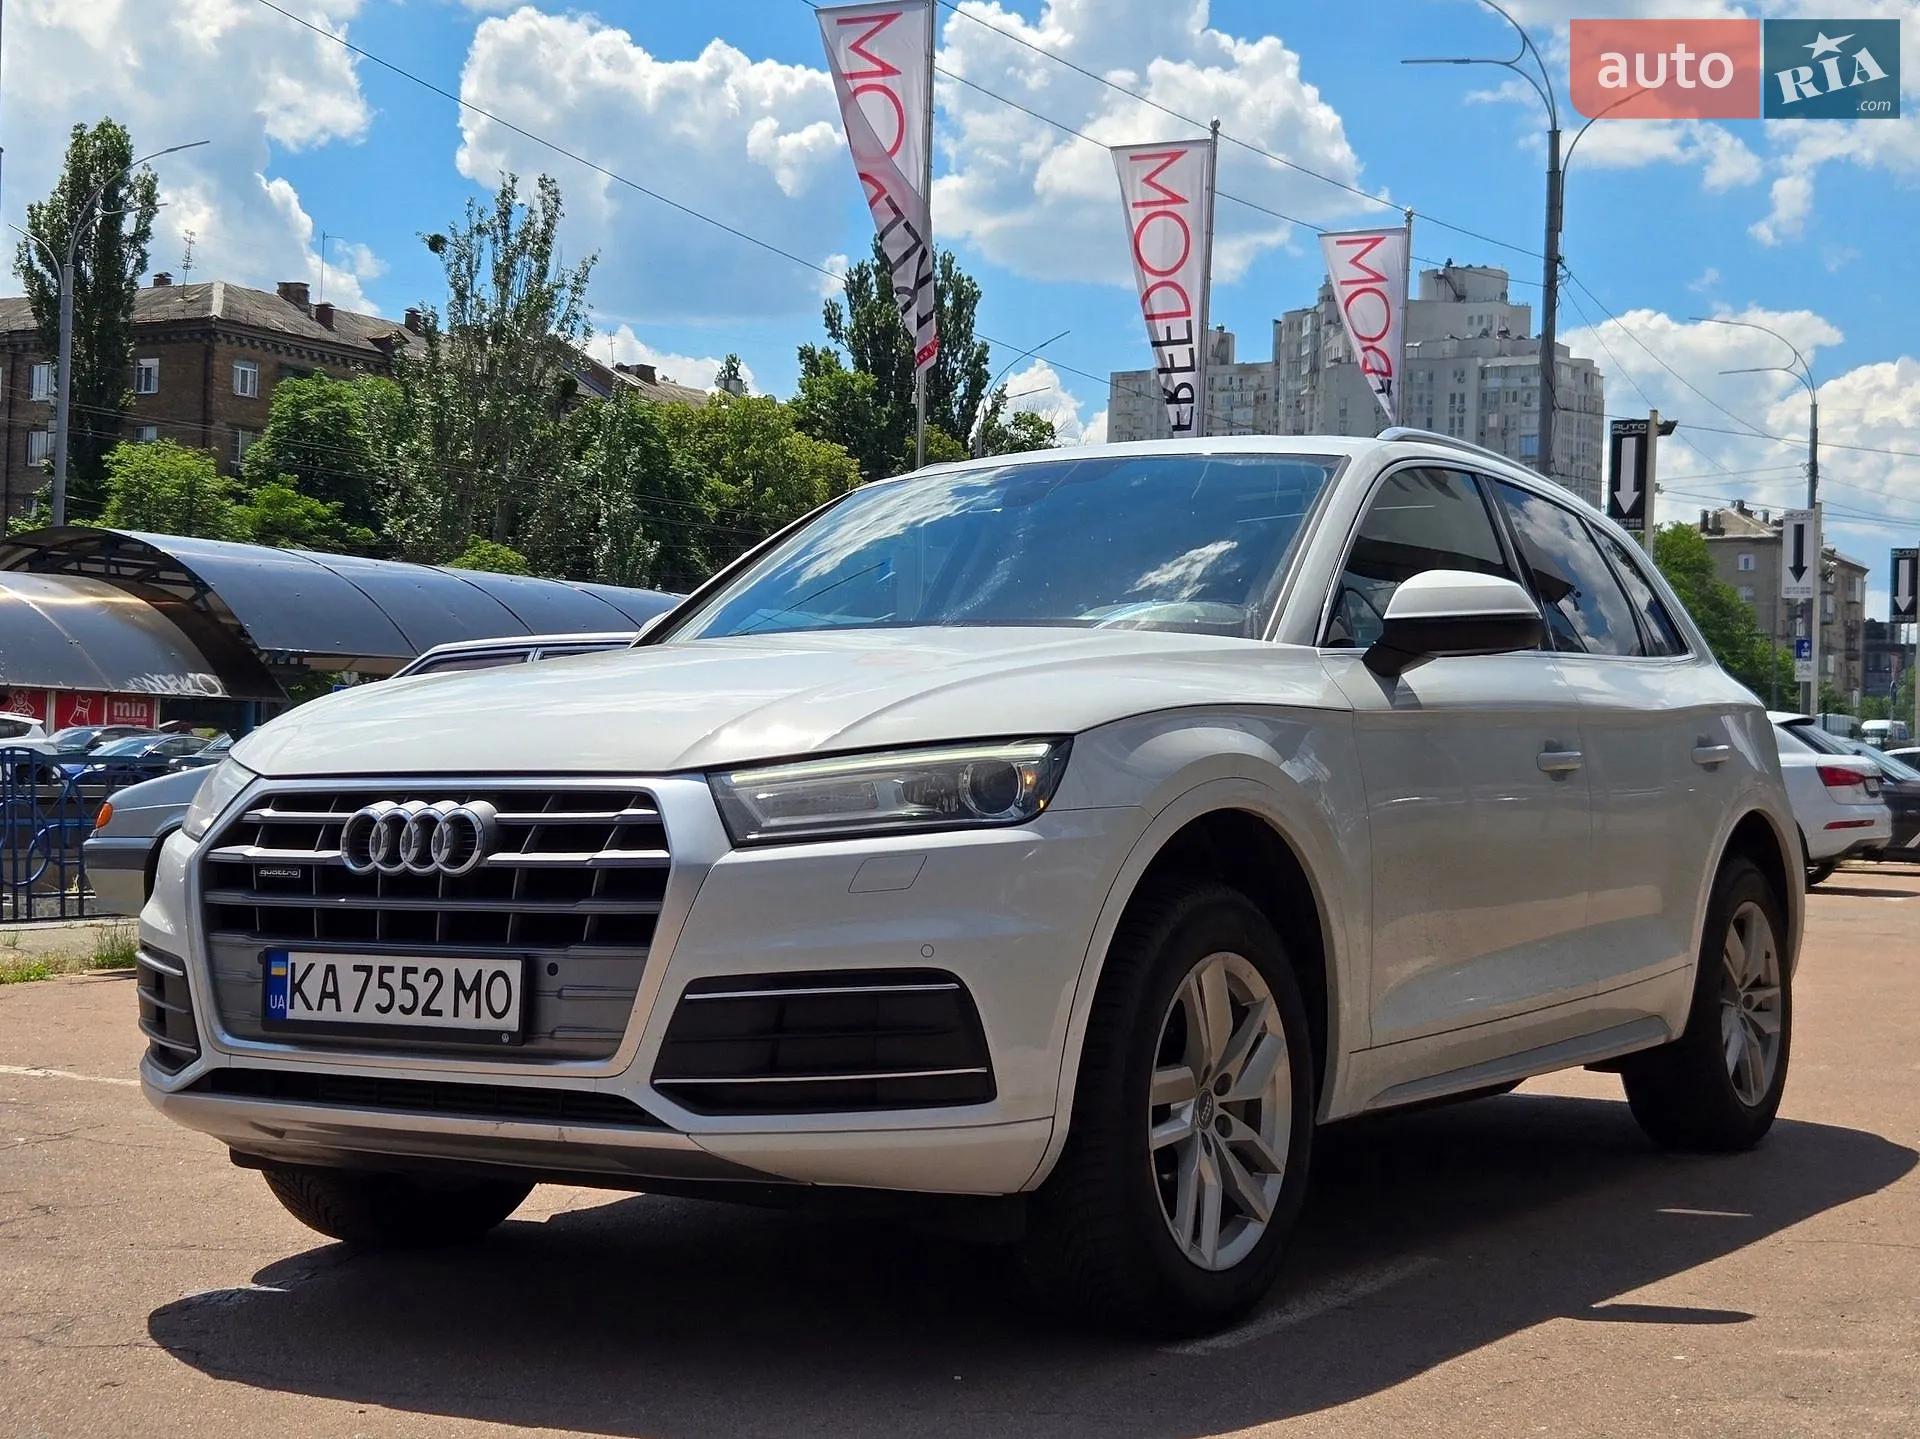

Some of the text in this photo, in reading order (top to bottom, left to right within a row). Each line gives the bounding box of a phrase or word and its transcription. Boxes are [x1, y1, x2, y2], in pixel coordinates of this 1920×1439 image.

[113, 698, 148, 717] min
[259, 868, 298, 877] quattro
[288, 962, 512, 1020] KA 7552 MO
[270, 994, 286, 1010] UA
